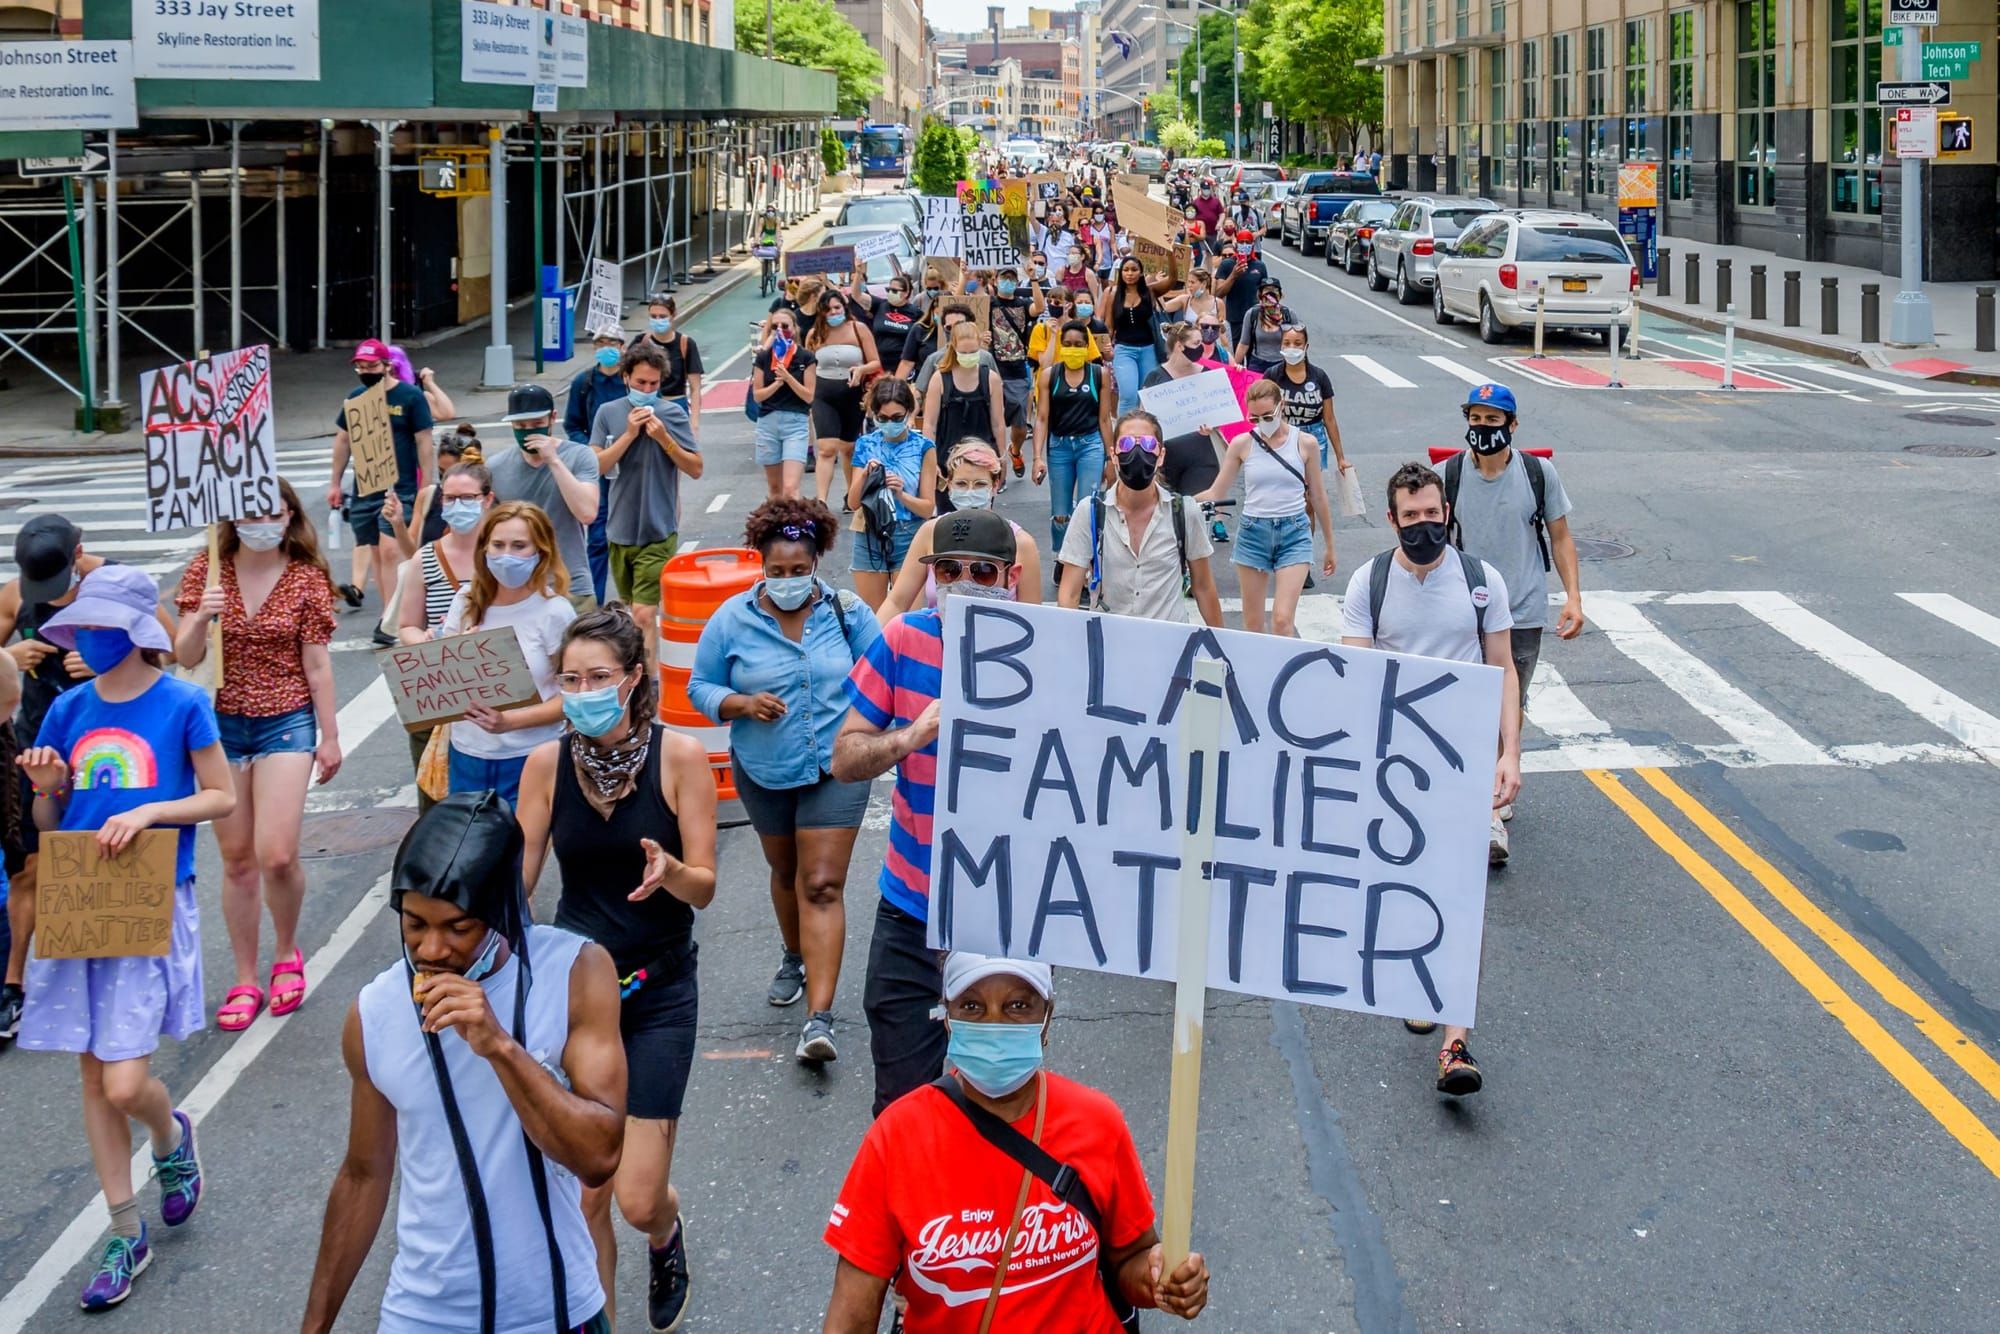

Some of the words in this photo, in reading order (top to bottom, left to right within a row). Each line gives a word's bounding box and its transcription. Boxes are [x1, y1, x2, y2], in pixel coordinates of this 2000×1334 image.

[155, 0, 191, 16] 333
[197, 2, 228, 20] Jay
[234, 2, 295, 18] Street
[472, 9, 489, 25] 333
[489, 12, 504, 30] Jay
[505, 14, 531, 31] Street
[1893, 10, 1912, 21] BIKE
[1914, 10, 1936, 21] PATH
[157, 31, 201, 49] Skyline
[203, 32, 273, 48] Restoration
[275, 34, 297, 48] Inc.
[0, 49, 63, 66] Johnson
[67, 48, 118, 64] Street
[1923, 45, 1966, 60] Johnson
[1970, 44, 1978, 54] St
[1928, 63, 1951, 78] Tech
[19, 84, 89, 98] Restoration
[91, 83, 114, 97] Inc.
[1888, 89, 1907, 98] ONE
[1919, 88, 1940, 98] WAY
[1270, 115, 1280, 154] PARK
[960, 187, 1006, 205] ASIANS
[961, 202, 985, 215] FOR
[962, 214, 1009, 233] BLACK
[964, 231, 1009, 249] LIVES
[965, 247, 1021, 266] MATTER
[883, 319, 909, 331] umbro
[145, 359, 215, 429] ACS
[214, 346, 268, 426] DESTROYS
[348, 397, 388, 444] BLAC
[360, 430, 391, 464] LIVE
[1469, 429, 1506, 451] BLM
[145, 412, 270, 500] BLACK
[357, 455, 396, 489] MATTE
[151, 475, 275, 533] FAMILIES
[393, 637, 498, 675] BLACK
[400, 659, 512, 698] FAMILIES
[960, 603, 1465, 773] BLACK
[416, 682, 513, 716] MATTER
[947, 718, 1431, 866] FAMILIES
[39, 881, 169, 915] FAMILIES
[937, 827, 1445, 1014] MATTER
[40, 915, 169, 958] MATTER
[961, 1209, 995, 1224] Enjoy
[910, 1214, 1002, 1267] Jesus
[1002, 1201, 1090, 1258] Christ
[1024, 1257, 1051, 1269] Shalt
[1052, 1248, 1080, 1262] Never
